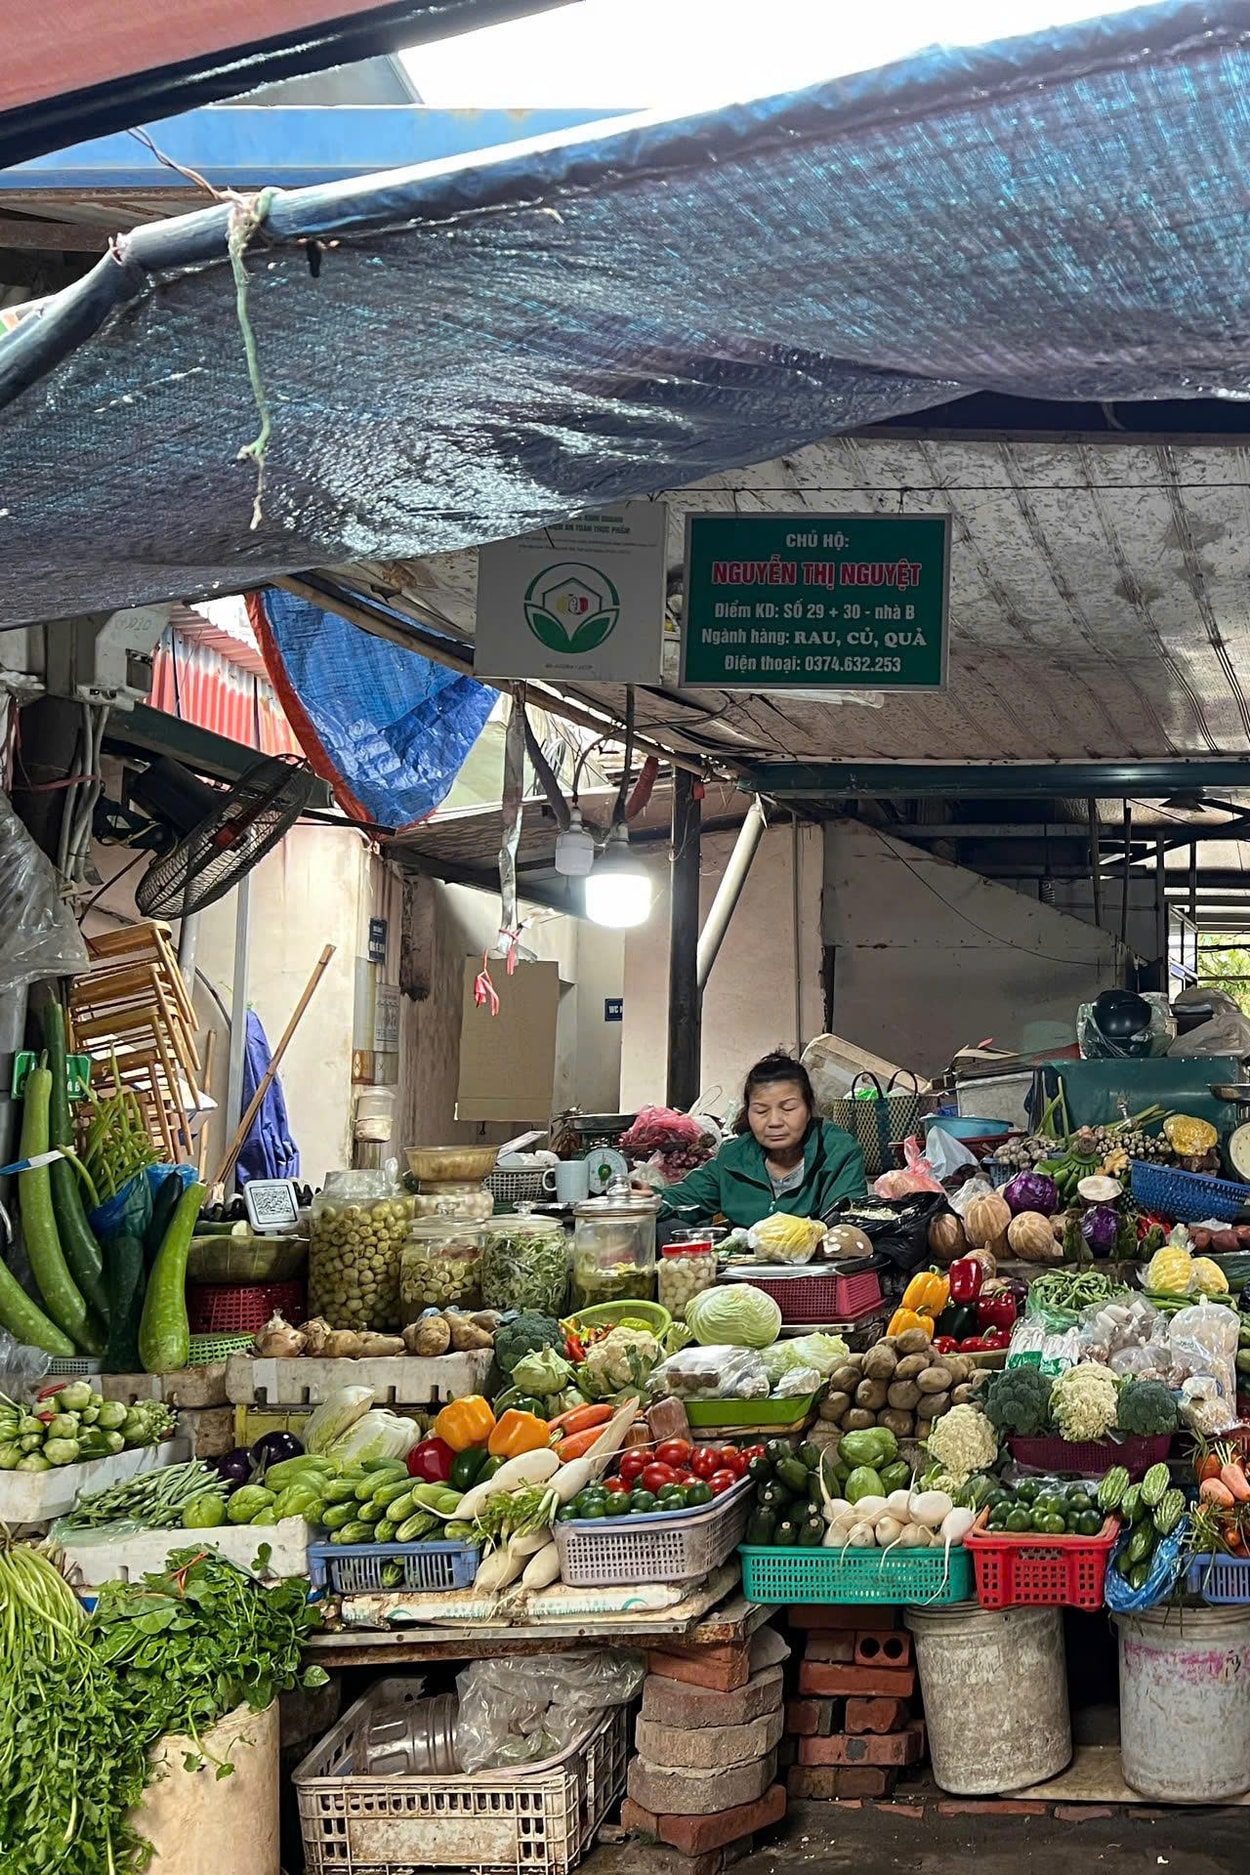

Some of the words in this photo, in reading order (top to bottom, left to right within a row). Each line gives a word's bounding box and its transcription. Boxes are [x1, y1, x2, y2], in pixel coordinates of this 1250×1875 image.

[786, 530, 818, 548] CHỦ
[823, 531, 850, 550] HỘ:
[712, 554, 797, 586] NGUYỄN
[802, 561, 835, 590] THỊ
[840, 558, 923, 591] NGUYỆT
[715, 599, 751, 618] Điểm
[784, 598, 803, 618] SỐ
[806, 604, 824, 618] 29
[828, 606, 839, 618] +
[844, 604, 861, 619] 30
[874, 604, 901, 620] nhà
[906, 605, 915, 620] B
[702, 628, 746, 644] Ngành
[750, 629, 790, 646] hàng:
[794, 631, 842, 647] RAU,
[846, 627, 879, 648] CỦ,
[884, 628, 928, 648] QUẢ
[724, 655, 756, 673] Điện
[760, 655, 801, 674] thoại:
[804, 656, 902, 672] 0374.632.253
